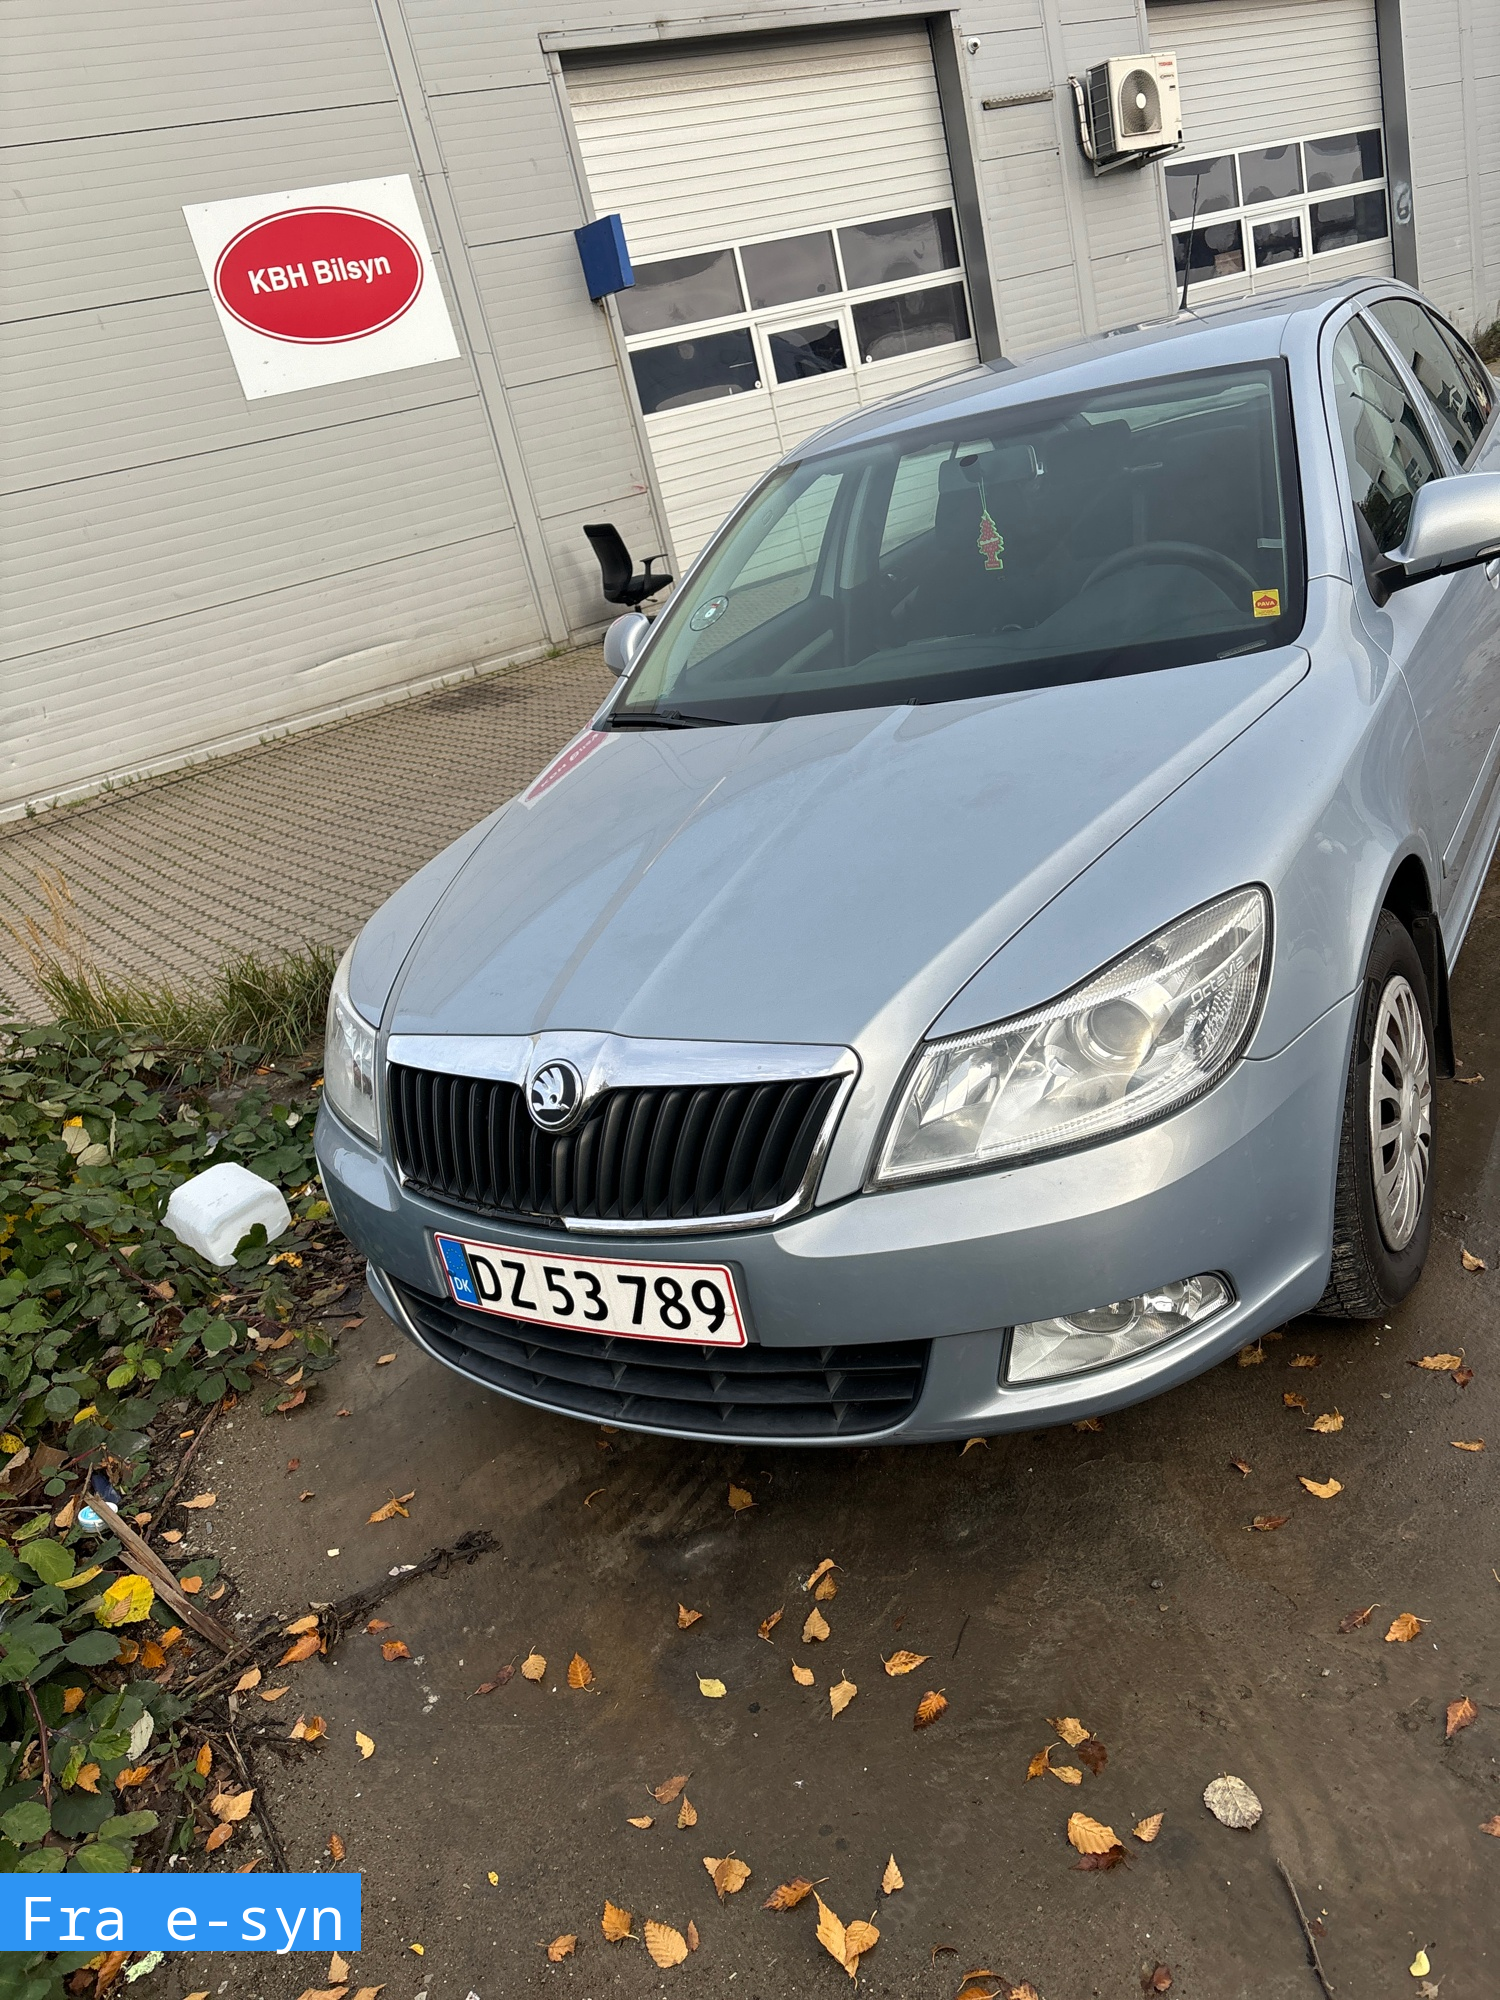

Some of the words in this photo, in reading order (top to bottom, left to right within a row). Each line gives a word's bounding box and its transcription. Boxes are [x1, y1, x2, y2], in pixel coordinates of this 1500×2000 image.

[247, 262, 309, 295] KBH
[311, 255, 392, 285] Bilsyn
[1190, 955, 1245, 1009] Octavia
[453, 1276, 472, 1293] DK
[468, 1253, 537, 1310] DZ
[543, 1266, 609, 1321] 53
[616, 1274, 727, 1334] 789
